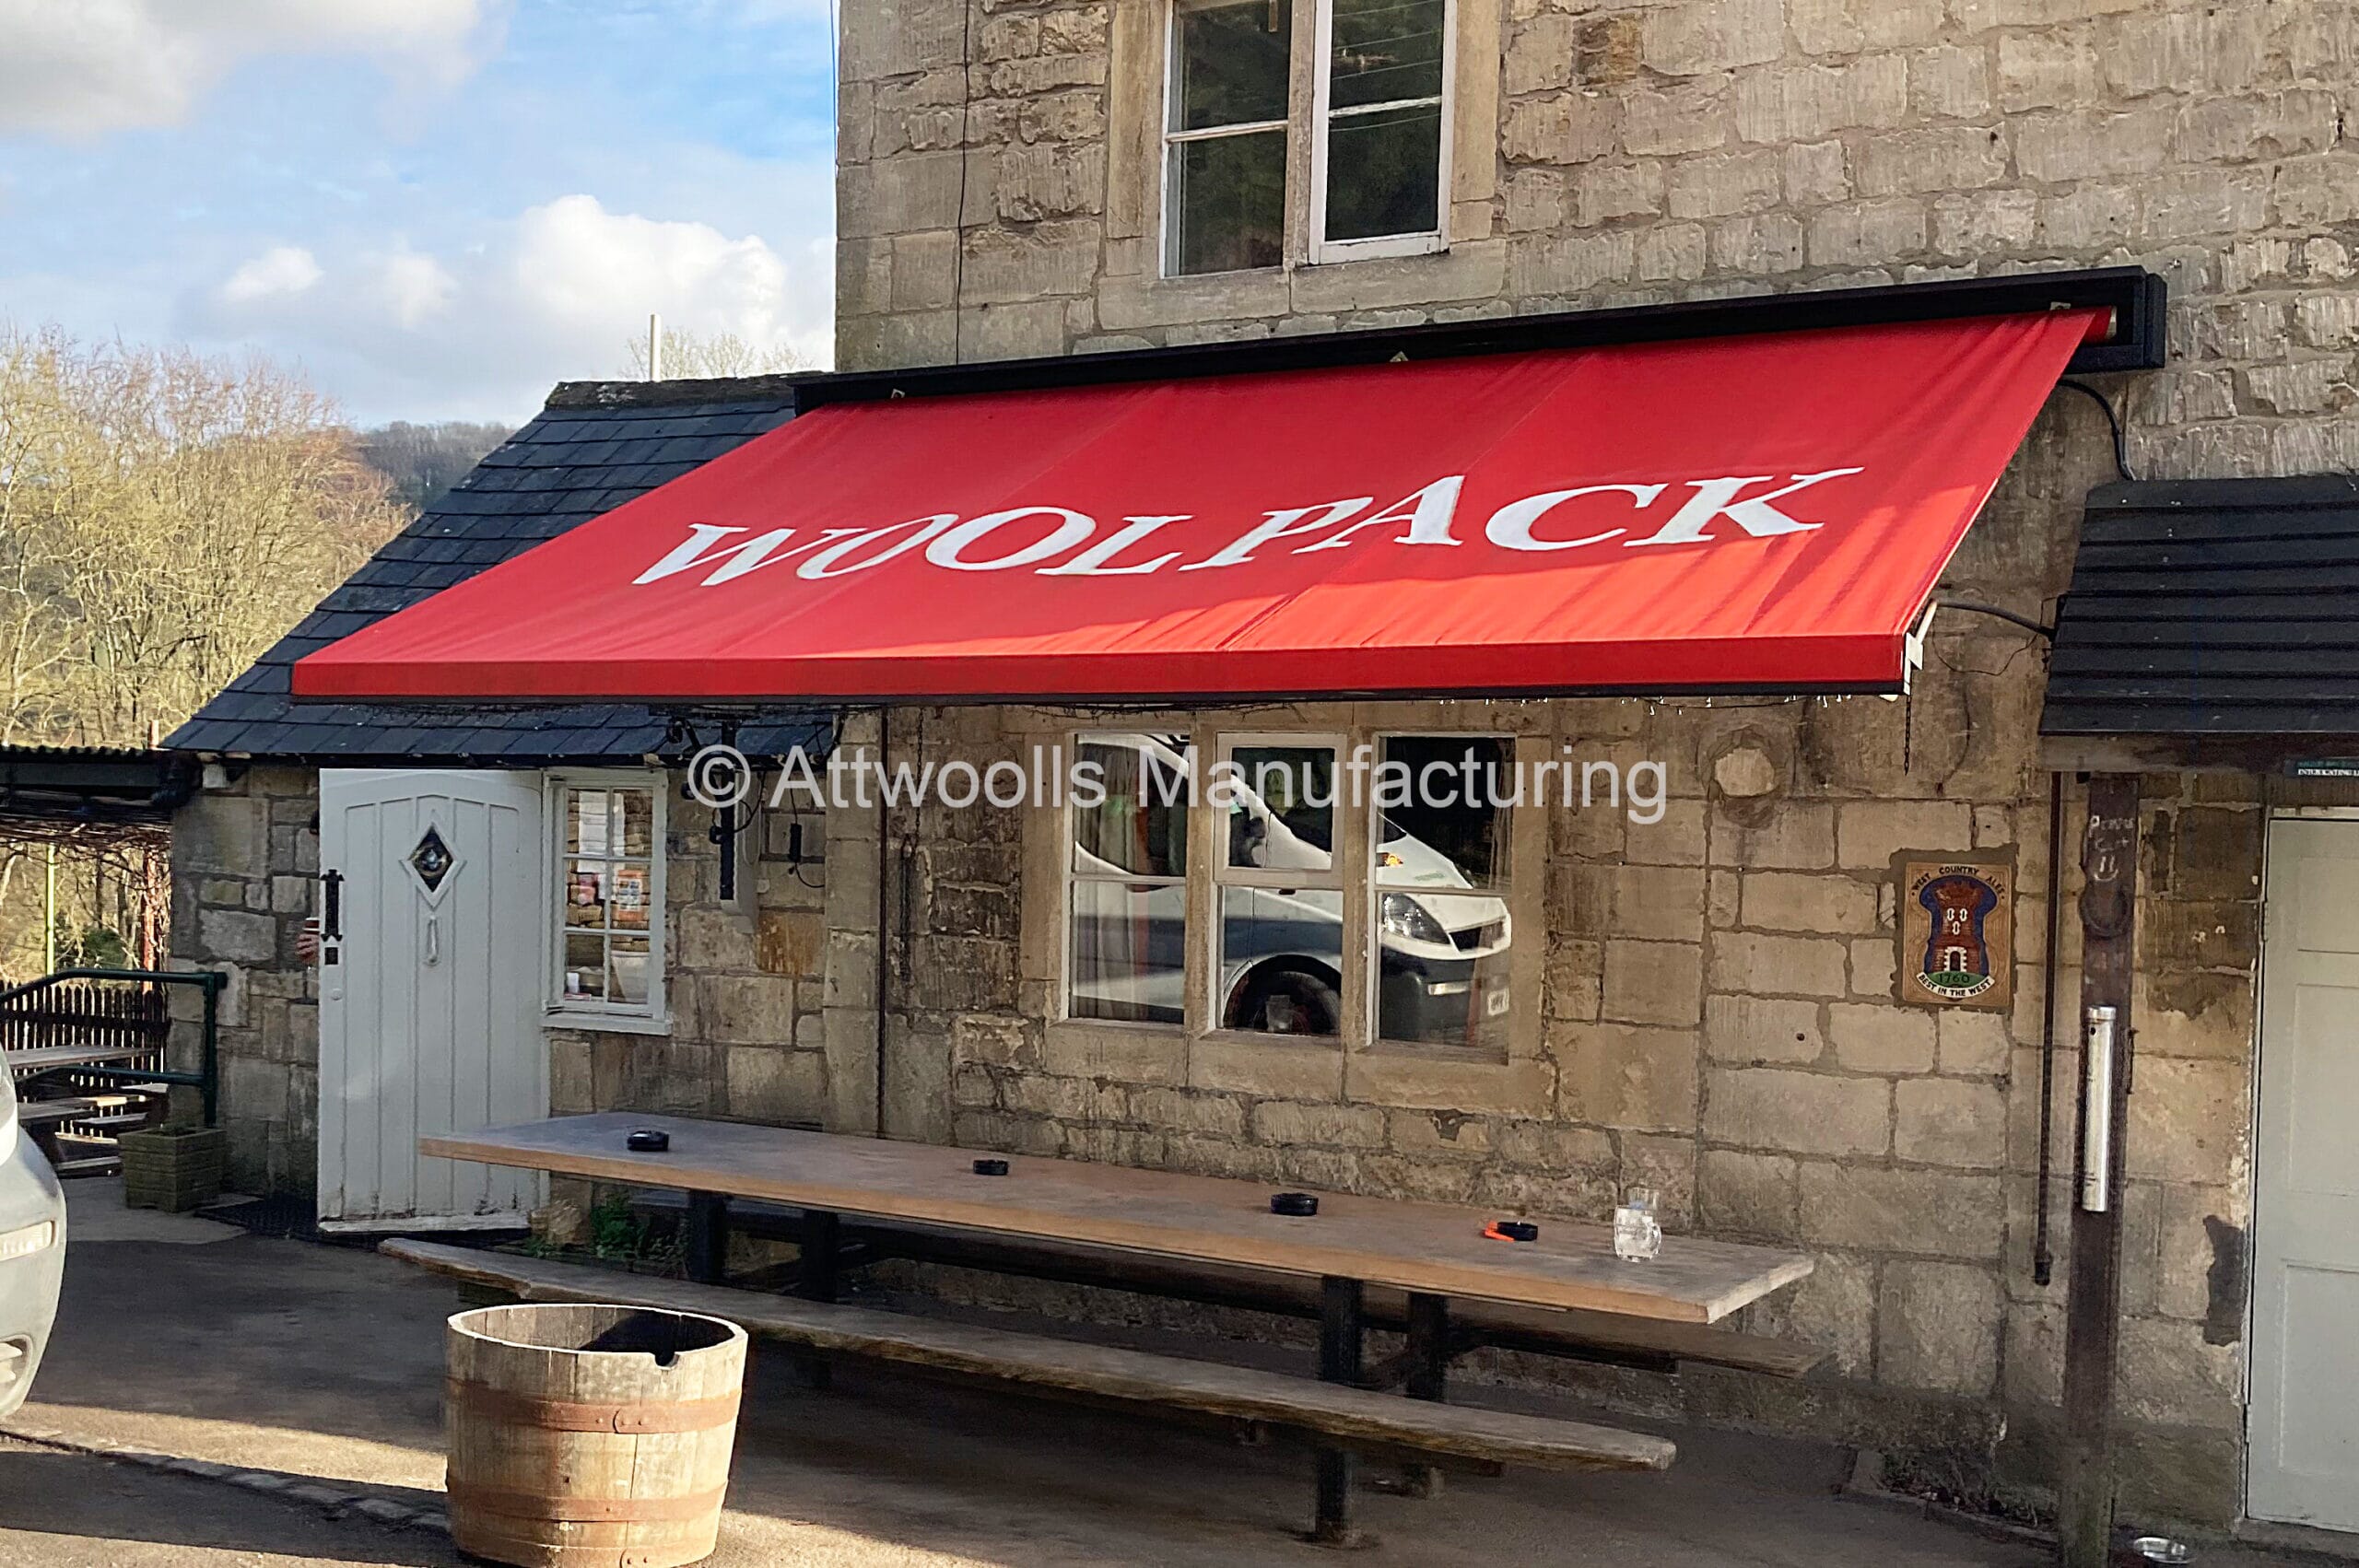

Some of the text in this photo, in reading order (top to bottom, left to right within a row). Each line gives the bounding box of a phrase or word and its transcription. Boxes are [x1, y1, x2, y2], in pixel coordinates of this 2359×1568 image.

[632, 466, 1864, 586] WOOLPACK
[1911, 866, 2005, 894] WEST COUNTRY ALES
[1919, 975, 1937, 990] BEST
[1937, 987, 1947, 995] IN
[1968, 978, 1991, 995] WEST
[1939, 974, 1970, 983] 1760
